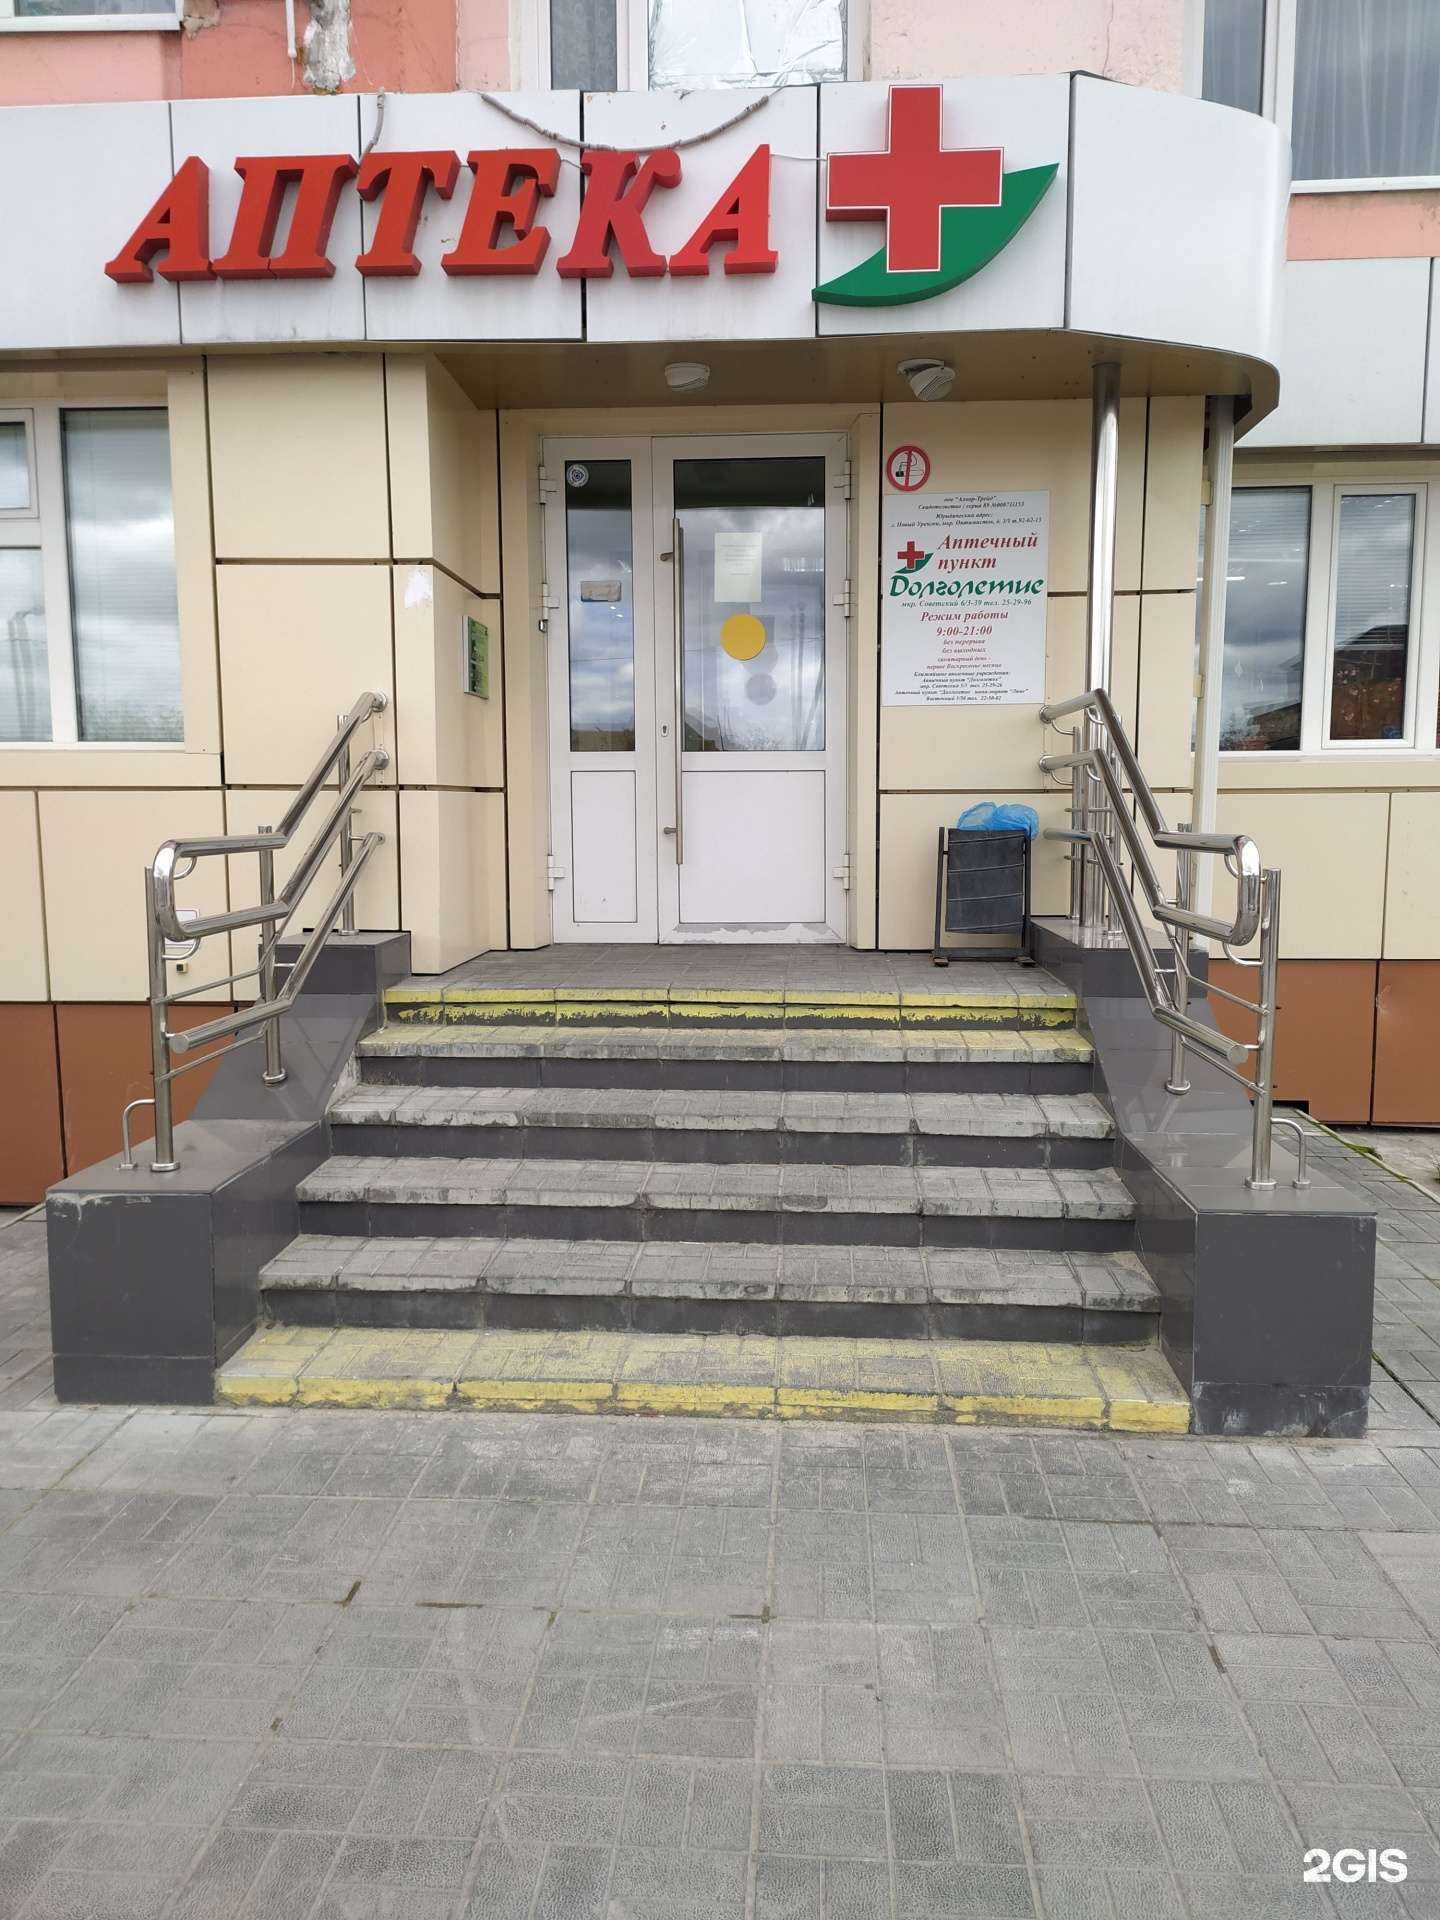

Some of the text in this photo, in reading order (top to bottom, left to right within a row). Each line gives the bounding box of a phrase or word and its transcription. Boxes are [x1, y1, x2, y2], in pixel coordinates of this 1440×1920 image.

[104, 144, 779, 283] АПТЕКА
[937, 532, 1038, 550] Аптечный
[937, 557, 997, 573] пункт
[890, 575, 1044, 599] Долголетие
[901, 601, 917, 610] мкр.
[919, 599, 959, 607] Советский
[983, 599, 1000, 607] тел.
[1001, 598, 1032, 607] 25-29-96
[920, 609, 1009, 624] Режим работы
[936, 625, 993, 637] 9:00-21:00
